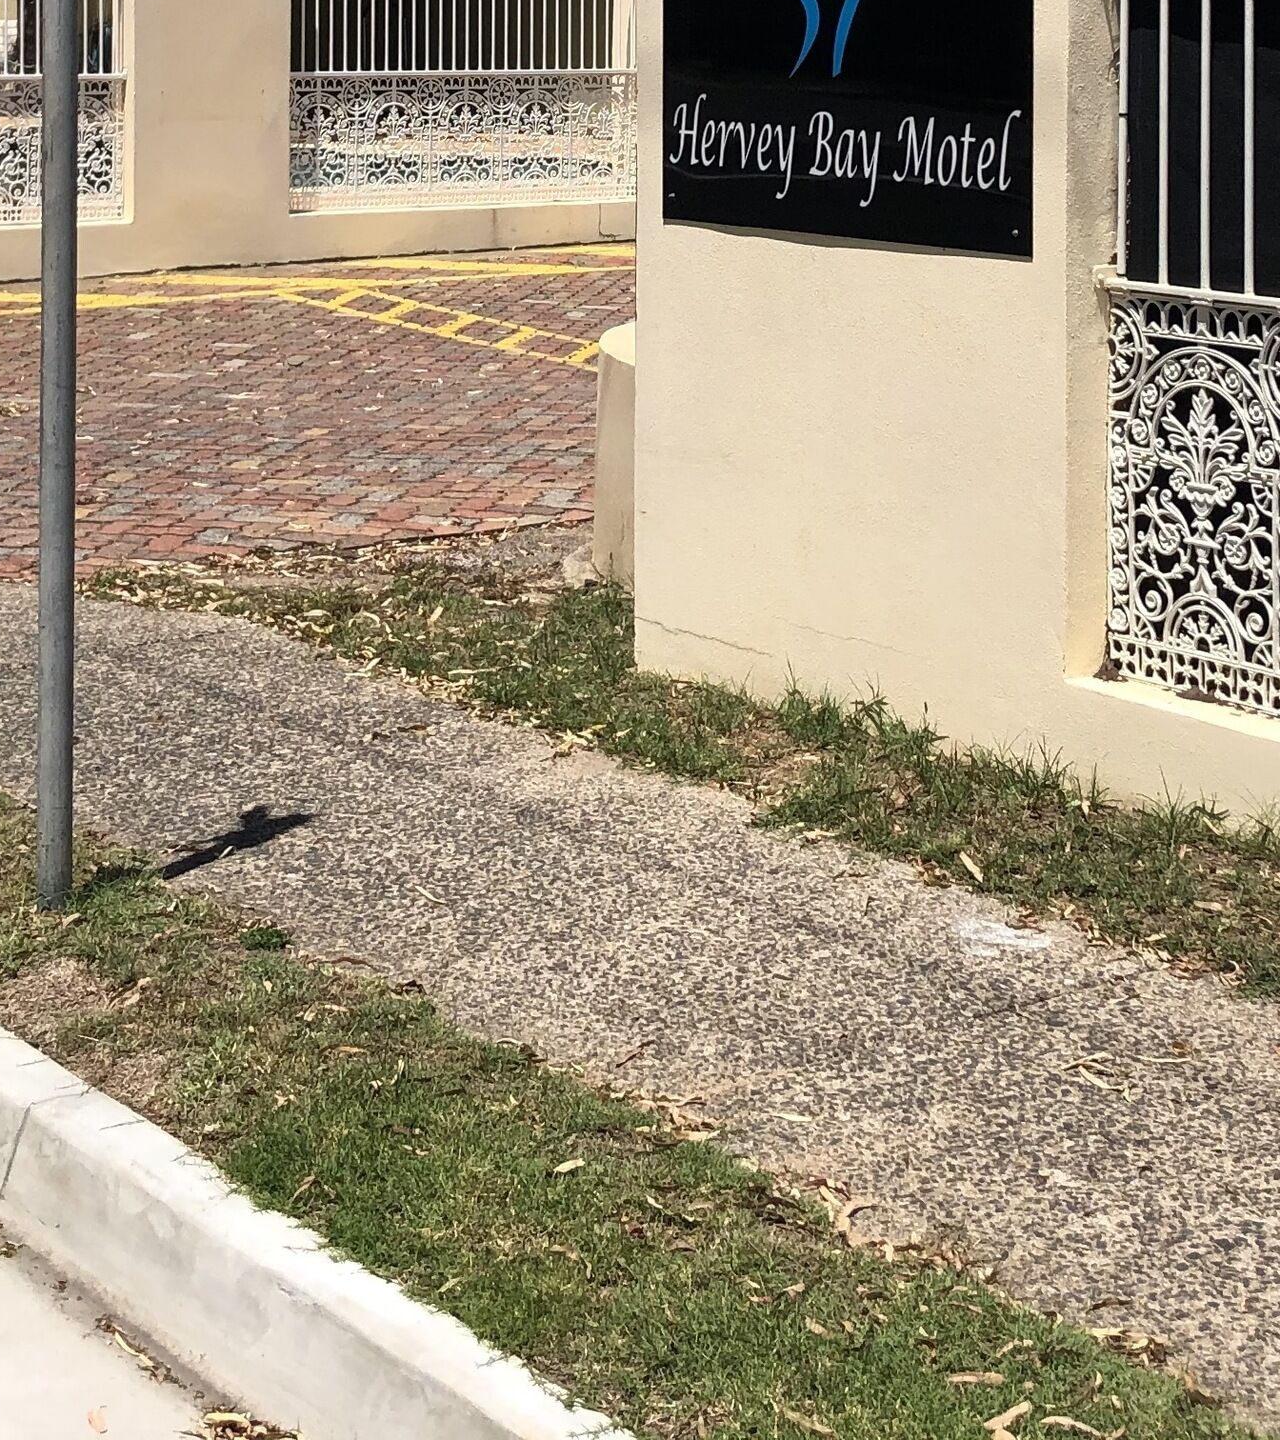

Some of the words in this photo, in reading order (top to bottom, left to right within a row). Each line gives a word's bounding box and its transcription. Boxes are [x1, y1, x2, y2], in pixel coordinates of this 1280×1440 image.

[669, 93, 796, 200] Hervey
[808, 110, 882, 208] Bay
[893, 109, 1022, 192] Motel
